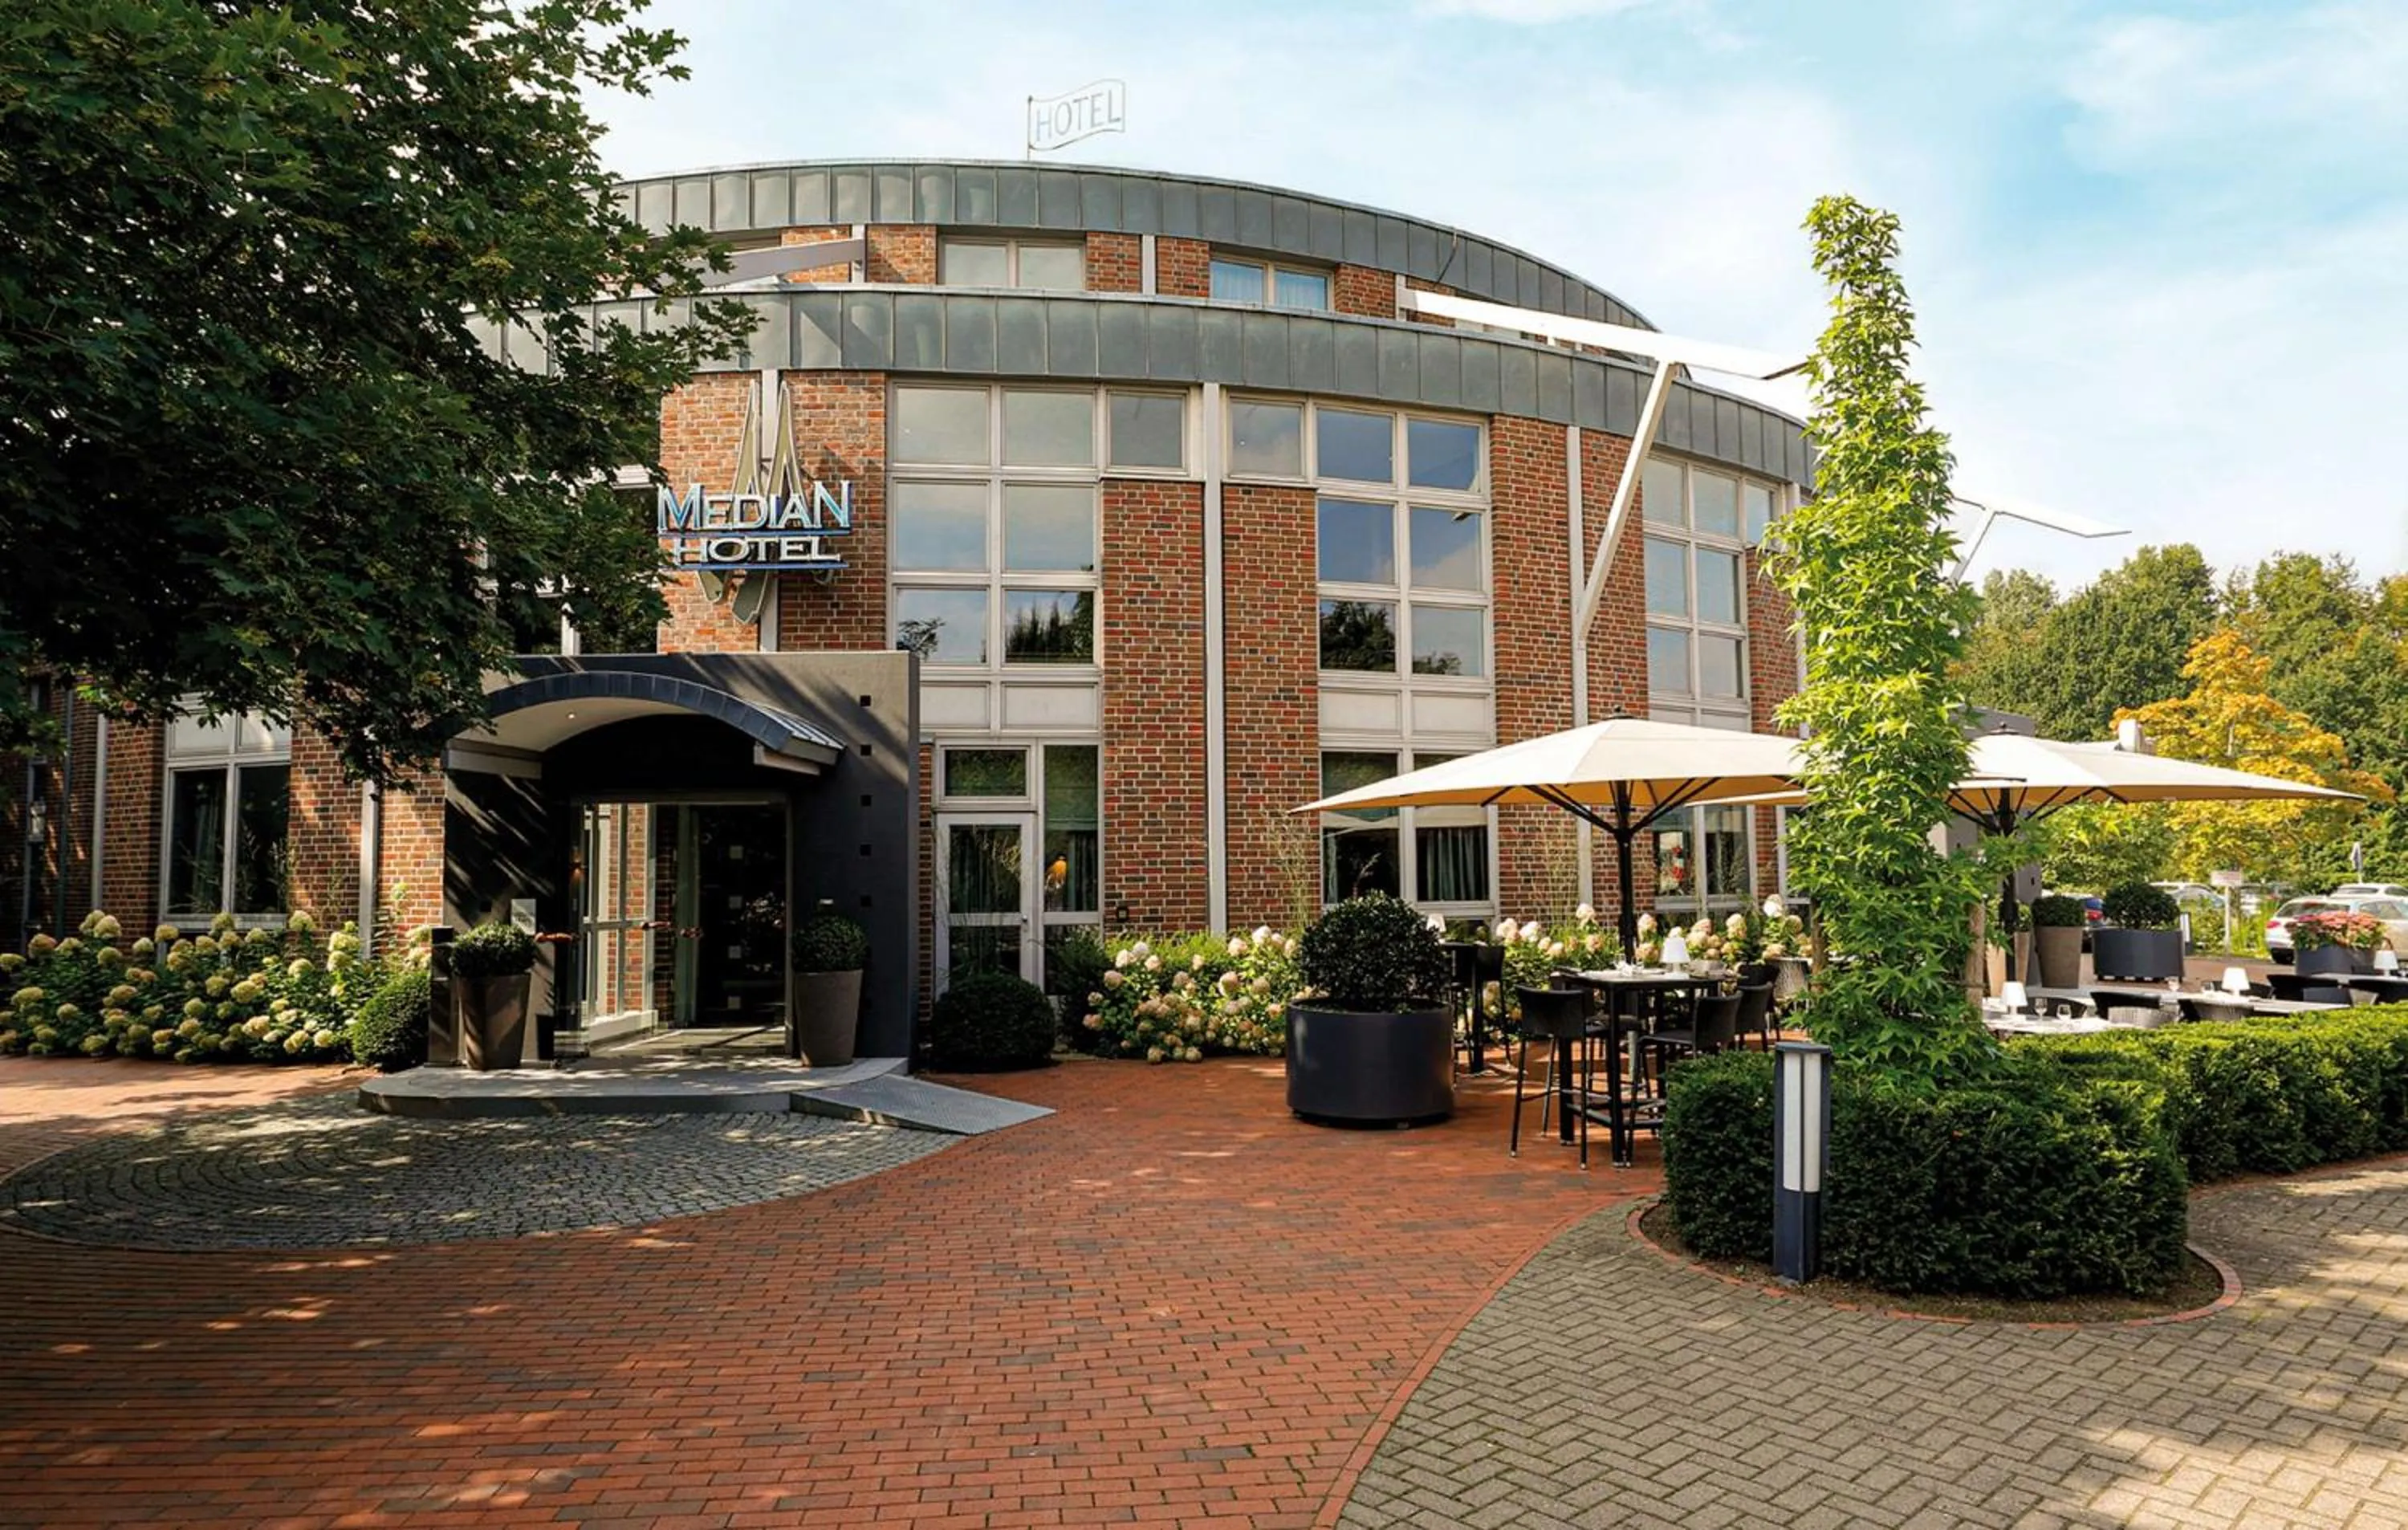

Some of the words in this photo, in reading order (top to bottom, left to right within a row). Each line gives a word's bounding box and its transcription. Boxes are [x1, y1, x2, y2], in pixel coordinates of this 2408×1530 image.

[1036, 89, 1121, 142] HOTEL
[657, 480, 852, 532] MEDIAN
[672, 535, 841, 562] HOTEL
